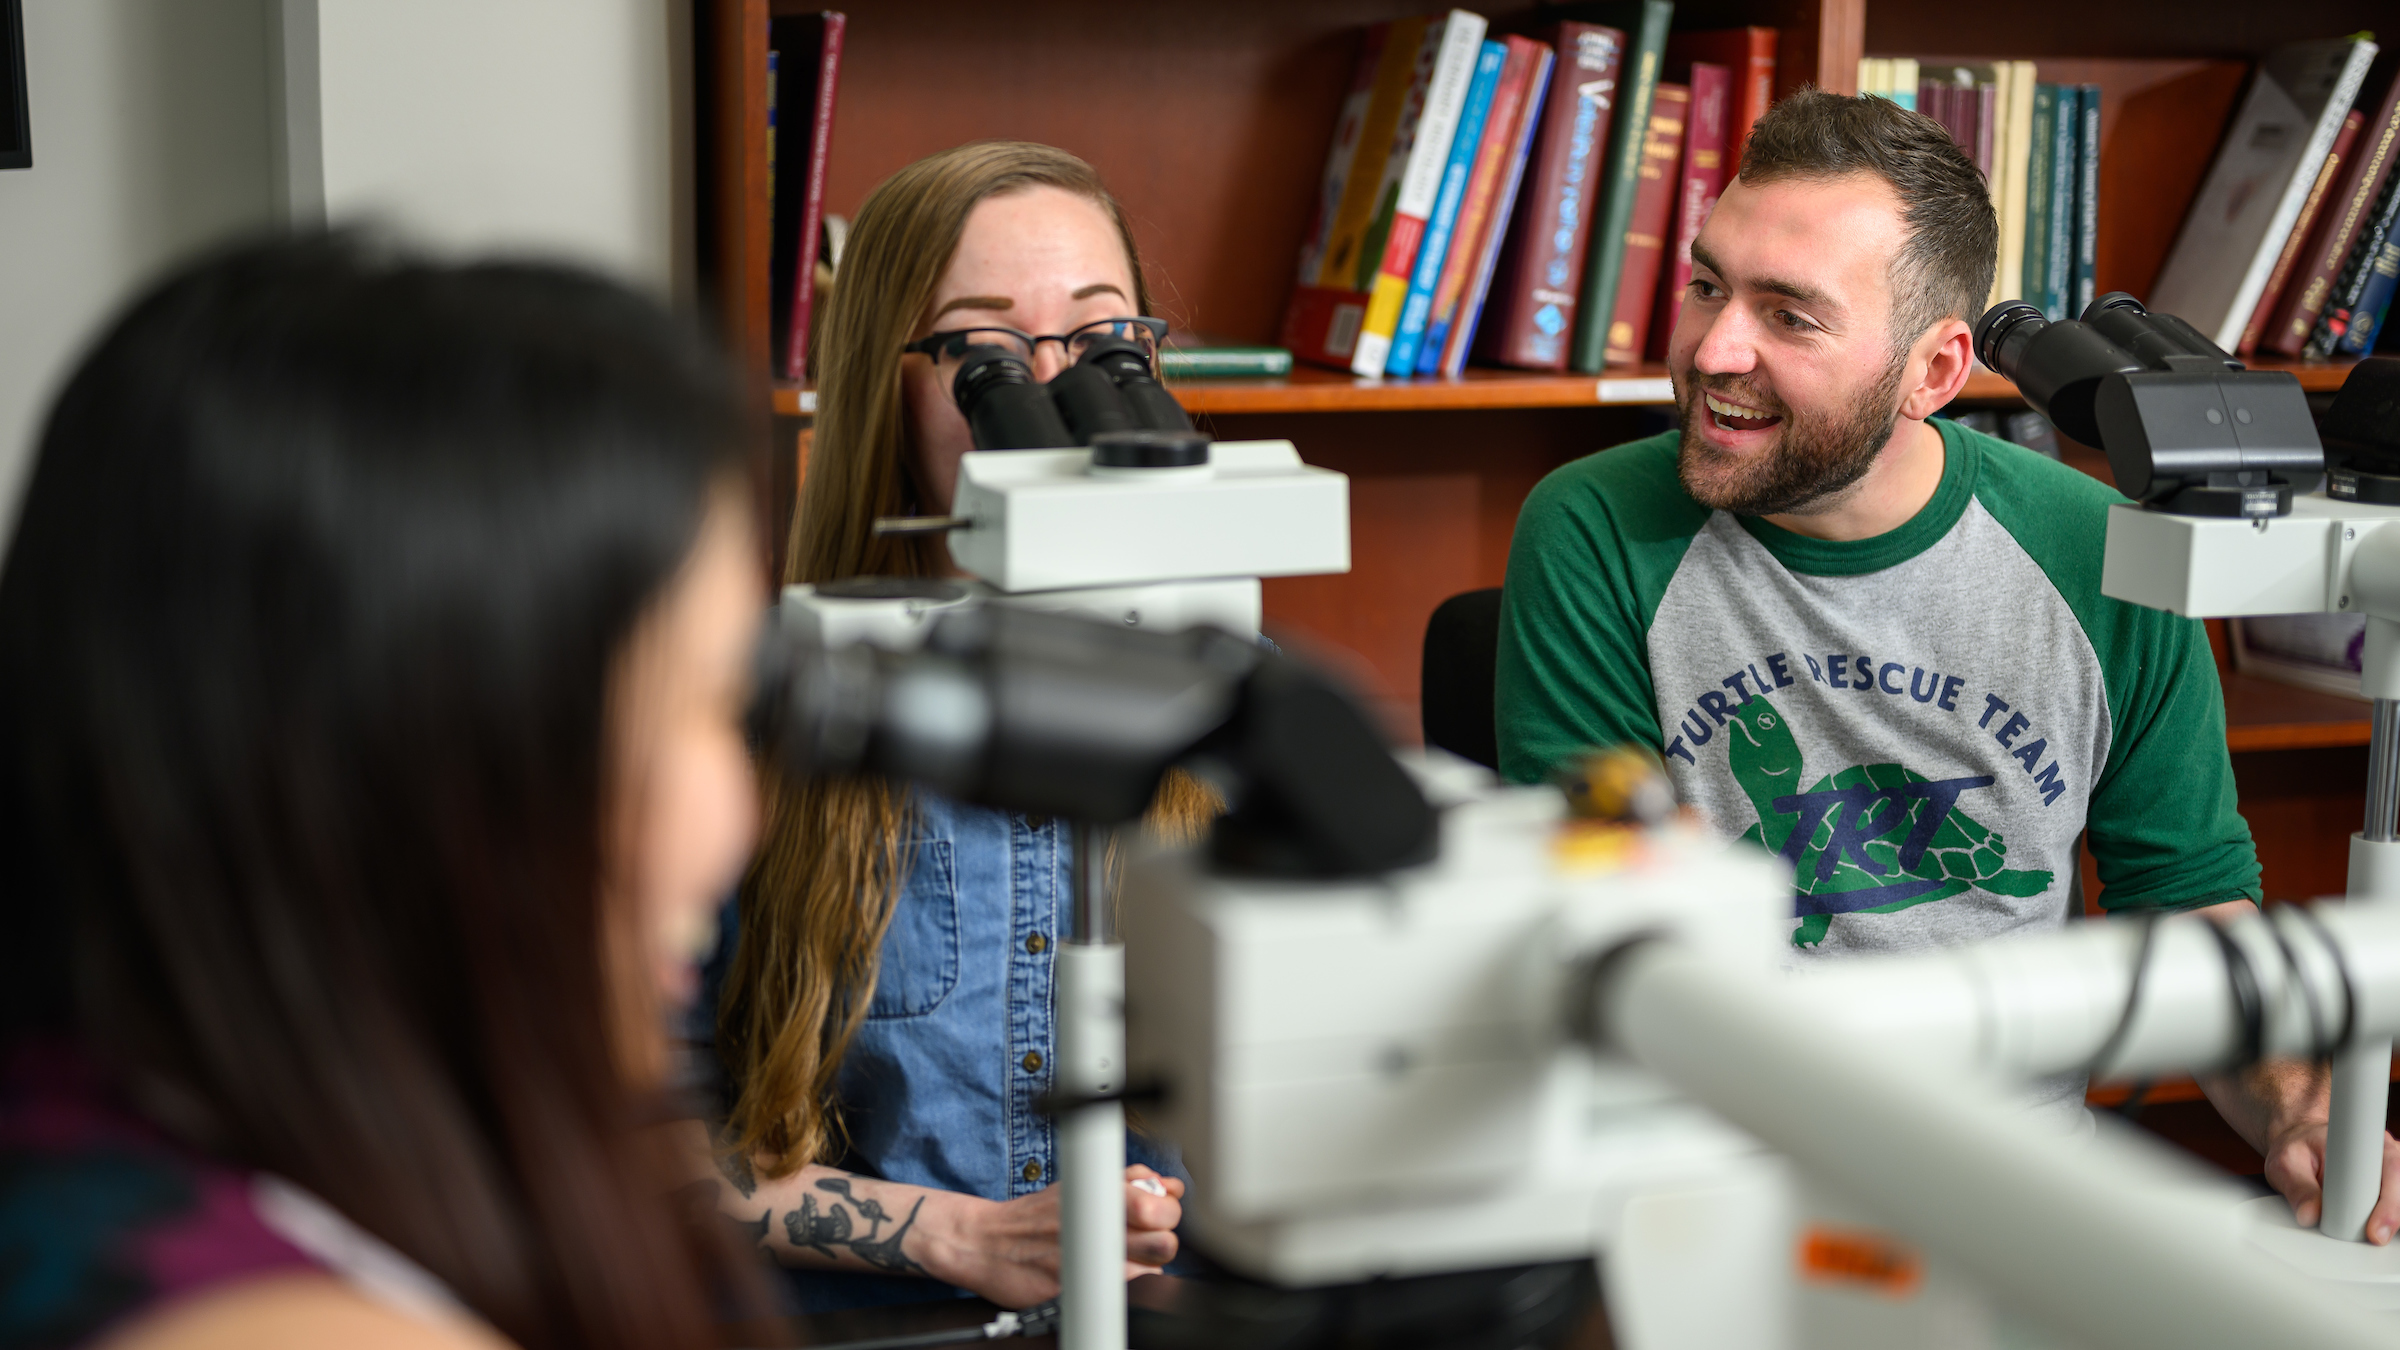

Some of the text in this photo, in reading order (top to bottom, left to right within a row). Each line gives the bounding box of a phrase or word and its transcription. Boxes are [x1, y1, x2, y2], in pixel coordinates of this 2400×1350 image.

[1665, 653, 2067, 807] TURTLE RESCUE TEAM
[1772, 775, 1995, 883] TRT
